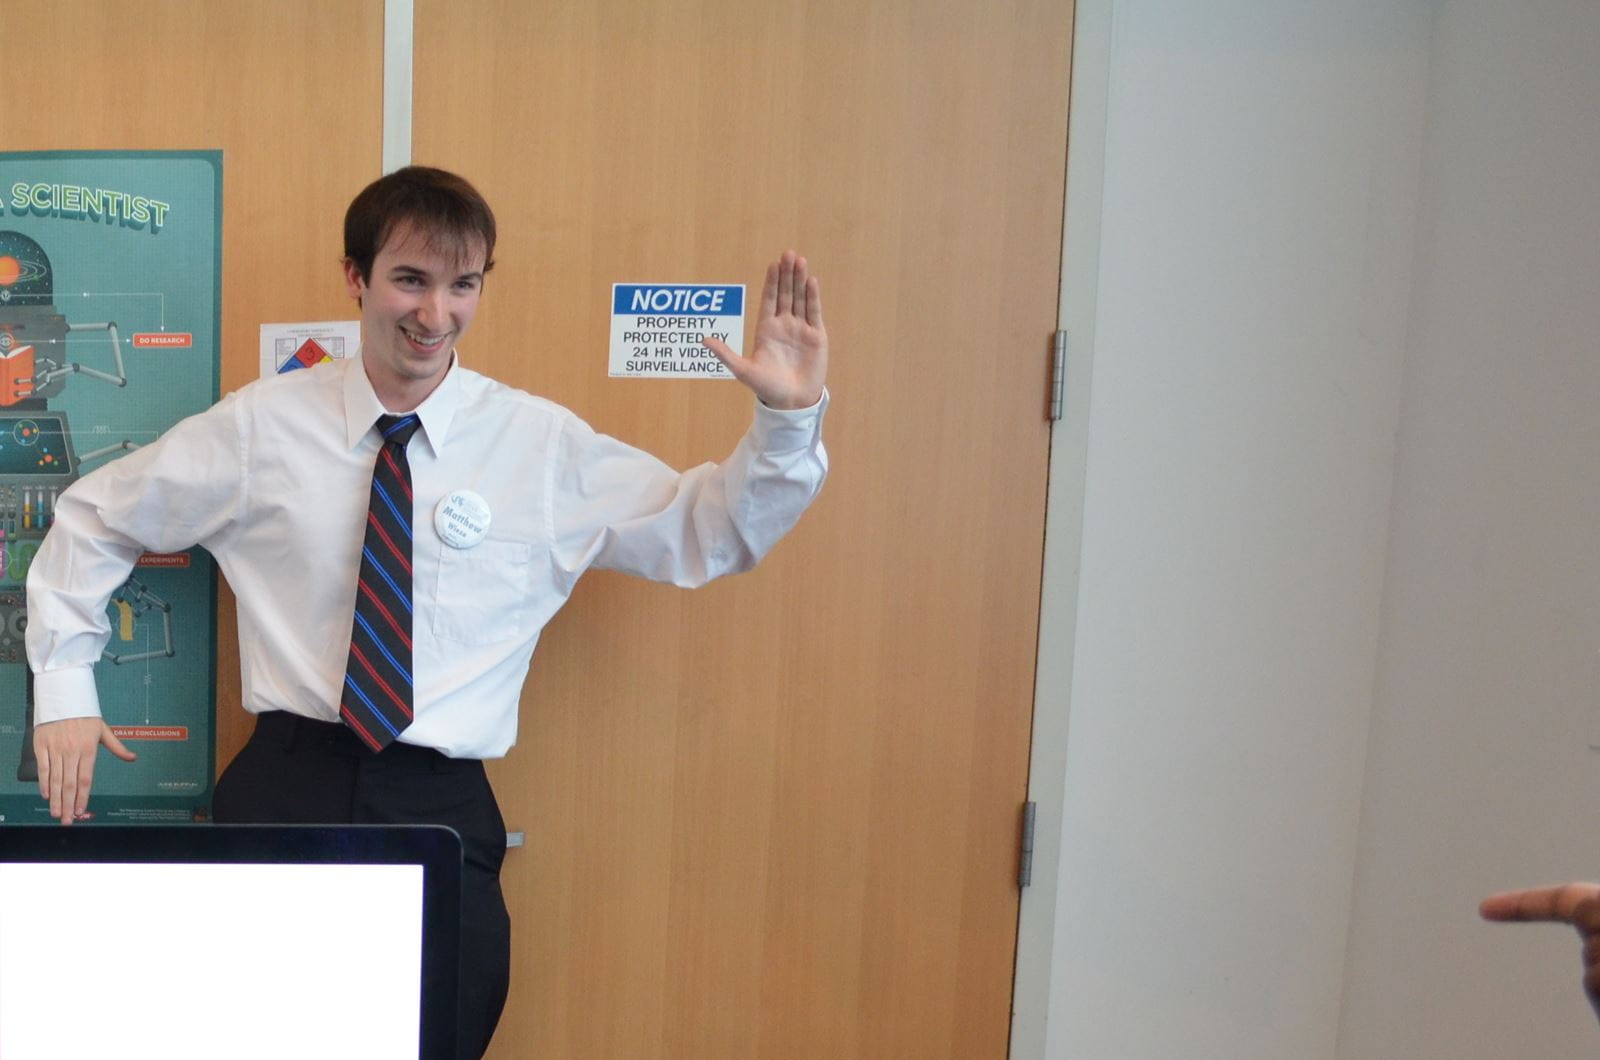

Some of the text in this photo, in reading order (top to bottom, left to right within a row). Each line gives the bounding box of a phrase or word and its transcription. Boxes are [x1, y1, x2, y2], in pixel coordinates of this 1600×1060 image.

[11, 182, 170, 229] SCIENTIST
[630, 289, 726, 312] NOTICE
[637, 317, 717, 328] PROPERTY
[623, 332, 704, 344] PROTECTED
[633, 347, 648, 357] 24
[655, 348, 672, 357] HR
[626, 361, 724, 373] SURVEILLANCE
[443, 506, 482, 533] Matthew
[140, 556, 185, 564] EXPERIMENTS
